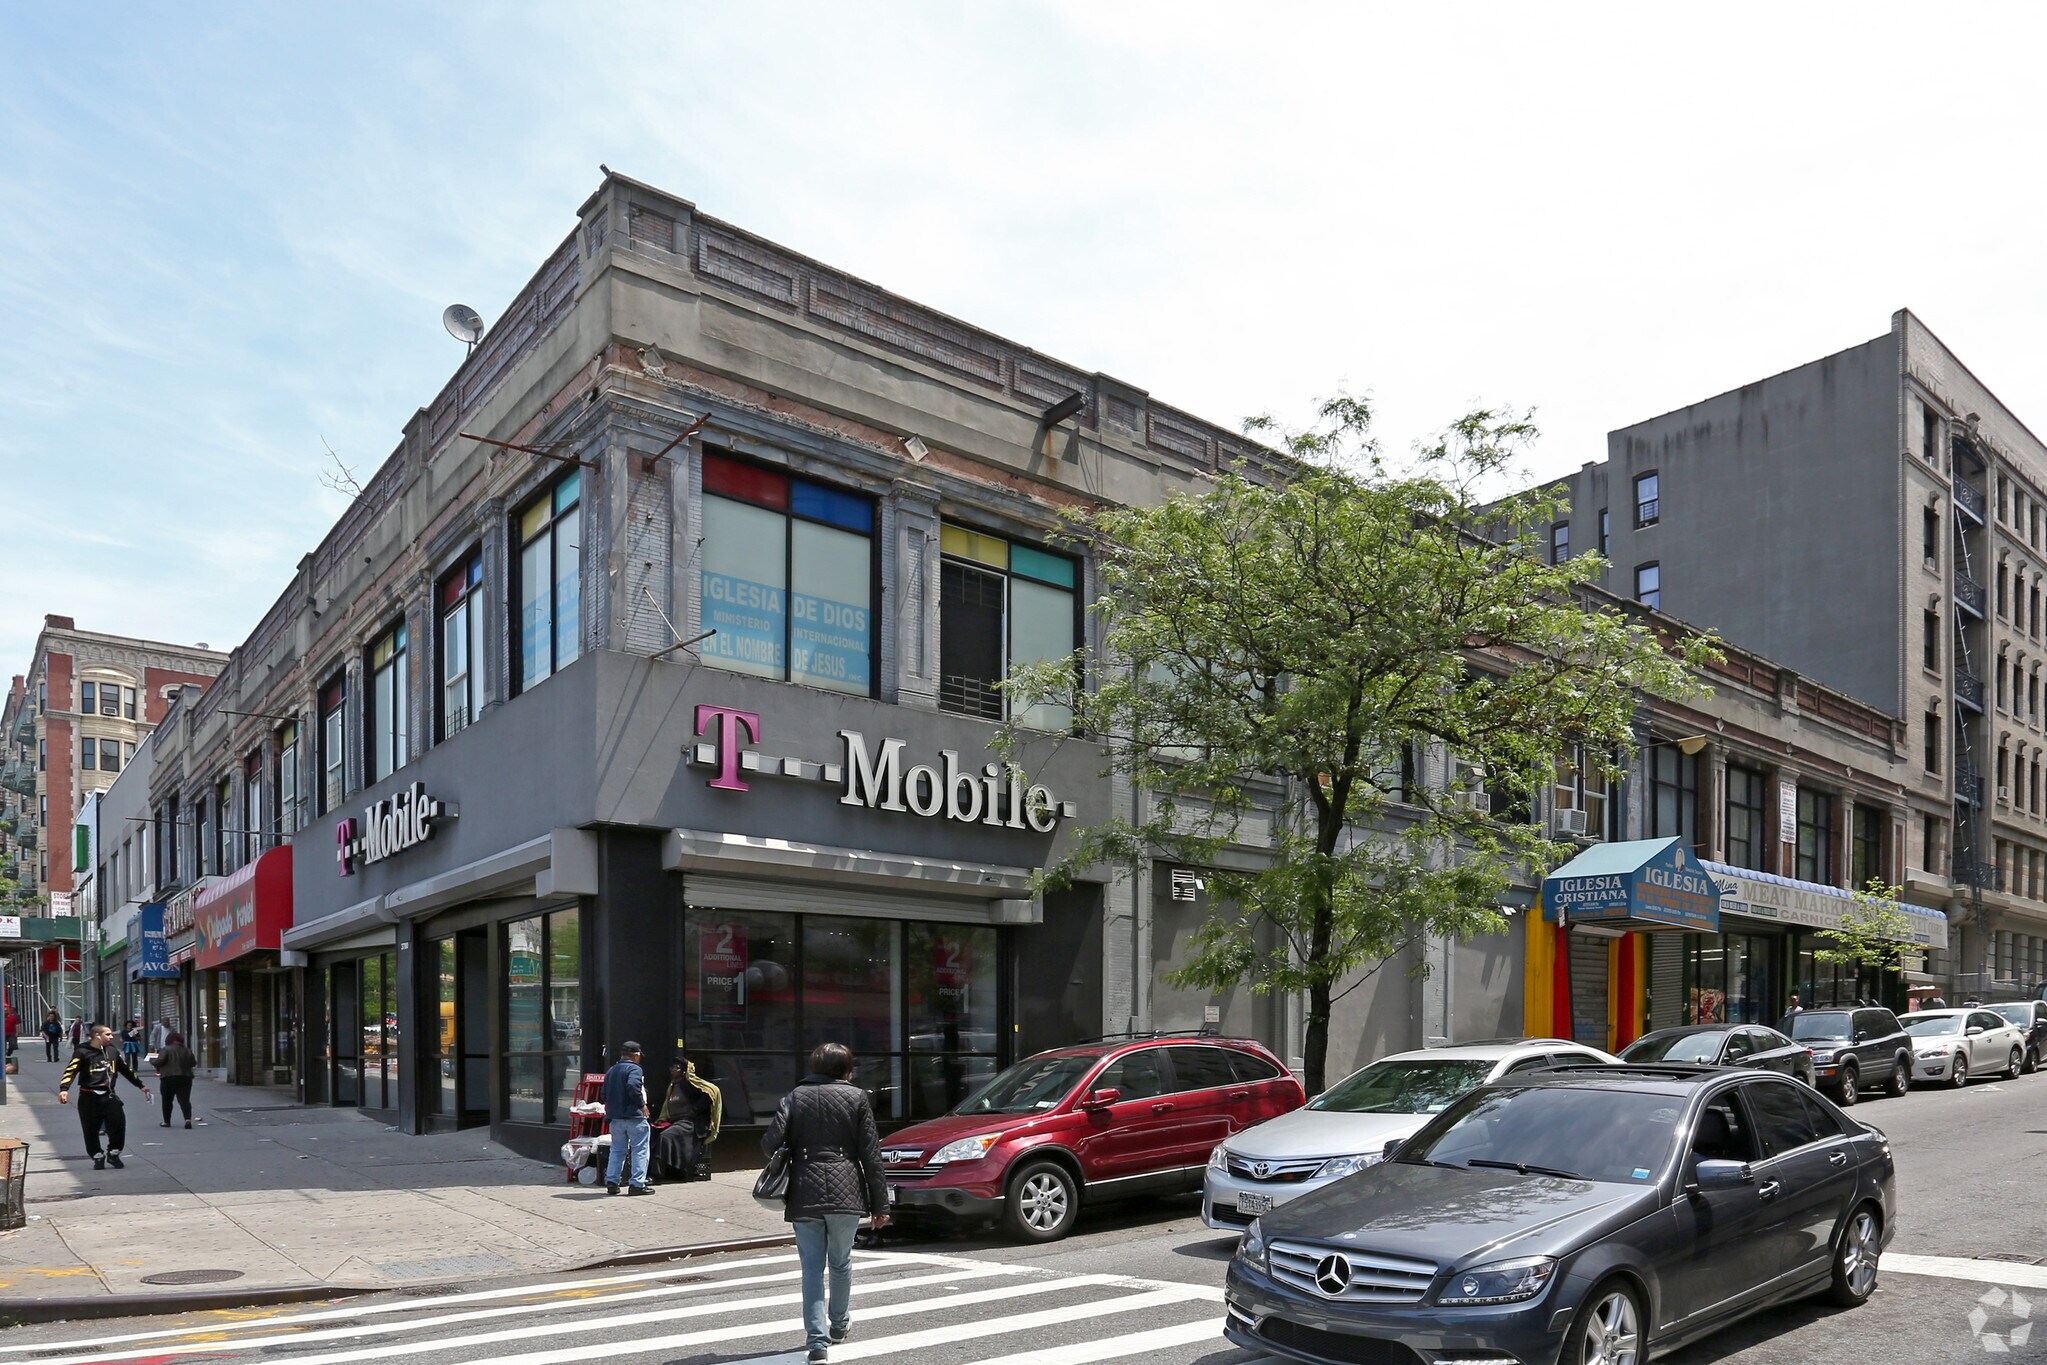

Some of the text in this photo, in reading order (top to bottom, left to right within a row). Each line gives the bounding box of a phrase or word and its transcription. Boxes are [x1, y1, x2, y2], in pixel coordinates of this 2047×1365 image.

[703, 575, 866, 632] IGLESIA DE DIOS
[713, 609, 865, 653] MINISTERIO INTERNACIONAL
[702, 629, 717, 653] EN
[720, 632, 734, 656] EL
[736, 635, 781, 664] NOMBRE
[794, 647, 808, 671] DE
[812, 651, 846, 678] JESUS
[1559, 875, 1623, 893] IGLESIA
[1644, 866, 1709, 896] IGLESIA
[1554, 889, 1628, 904] CRISTIANA
[1743, 881, 1791, 907] MEAT
[1794, 890, 1859, 917] MARKET
[716, 924, 733, 954] 2
[704, 953, 742, 961] ADDITIONAL
[707, 976, 733, 986] PRICE
[939, 987, 960, 997] PRICE
